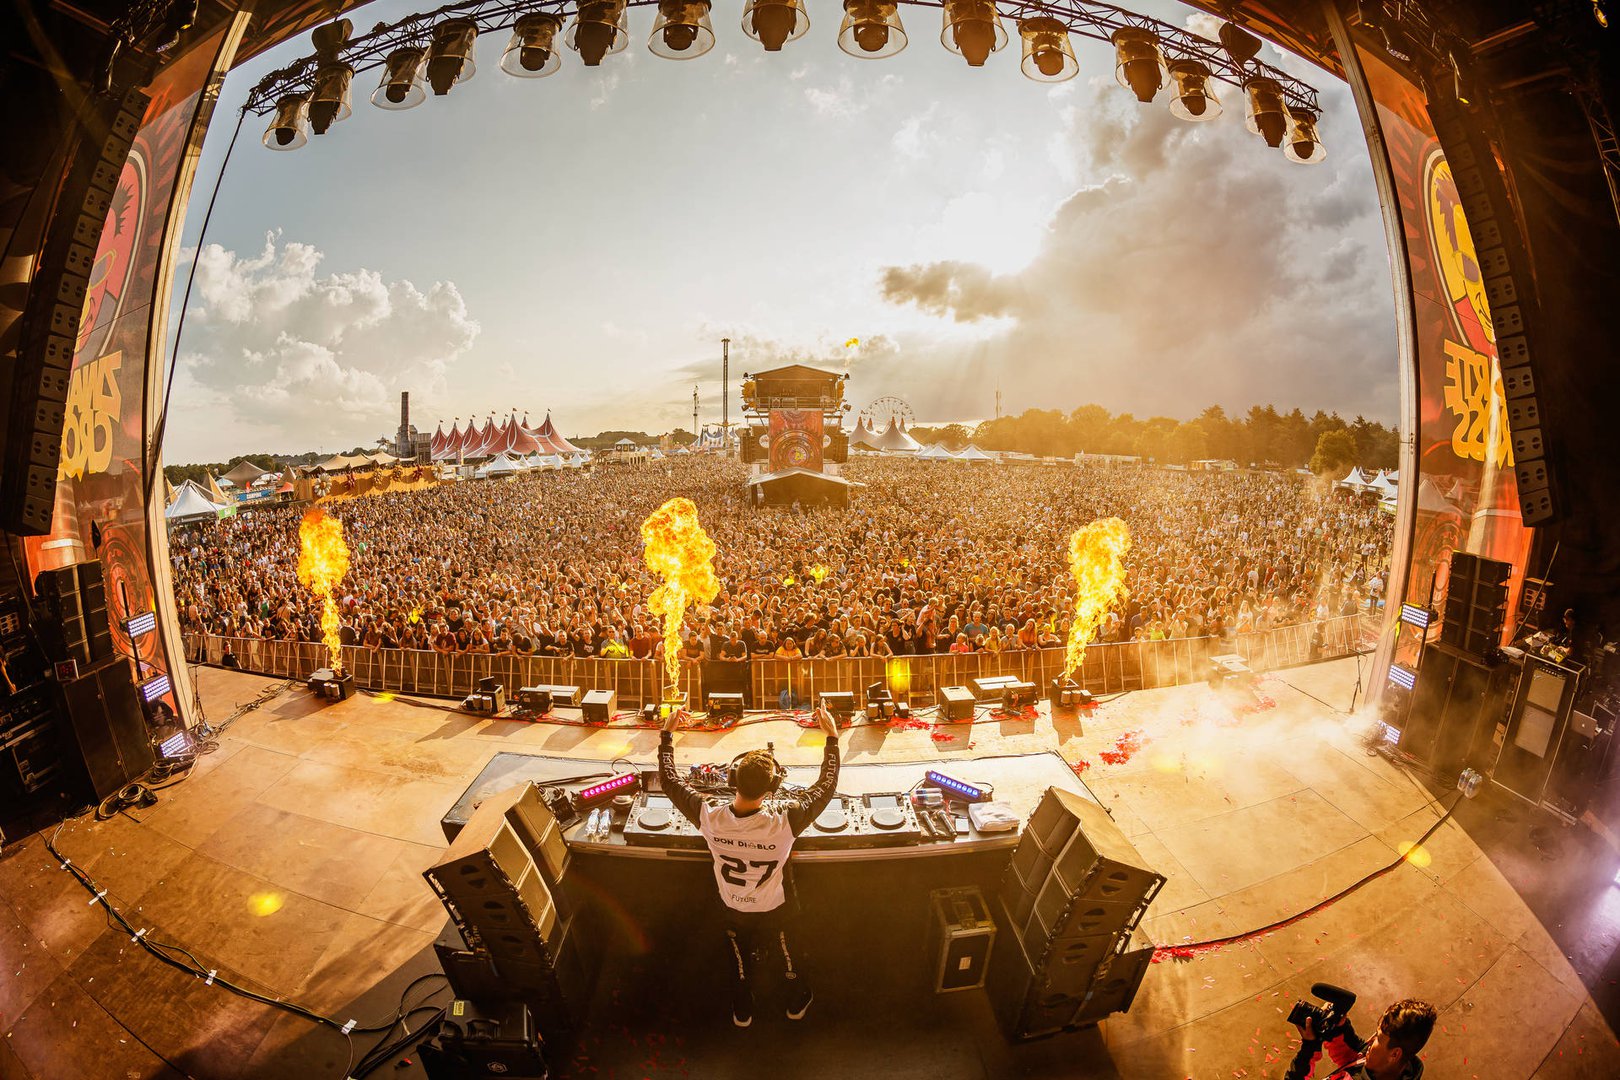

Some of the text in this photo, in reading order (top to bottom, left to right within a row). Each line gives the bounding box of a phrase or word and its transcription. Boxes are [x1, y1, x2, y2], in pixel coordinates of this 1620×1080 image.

[820, 753, 837, 790] FUTURE
[713, 836, 734, 846] DON
[719, 854, 779, 889] 27
[731, 894, 757, 904] FUTURE
